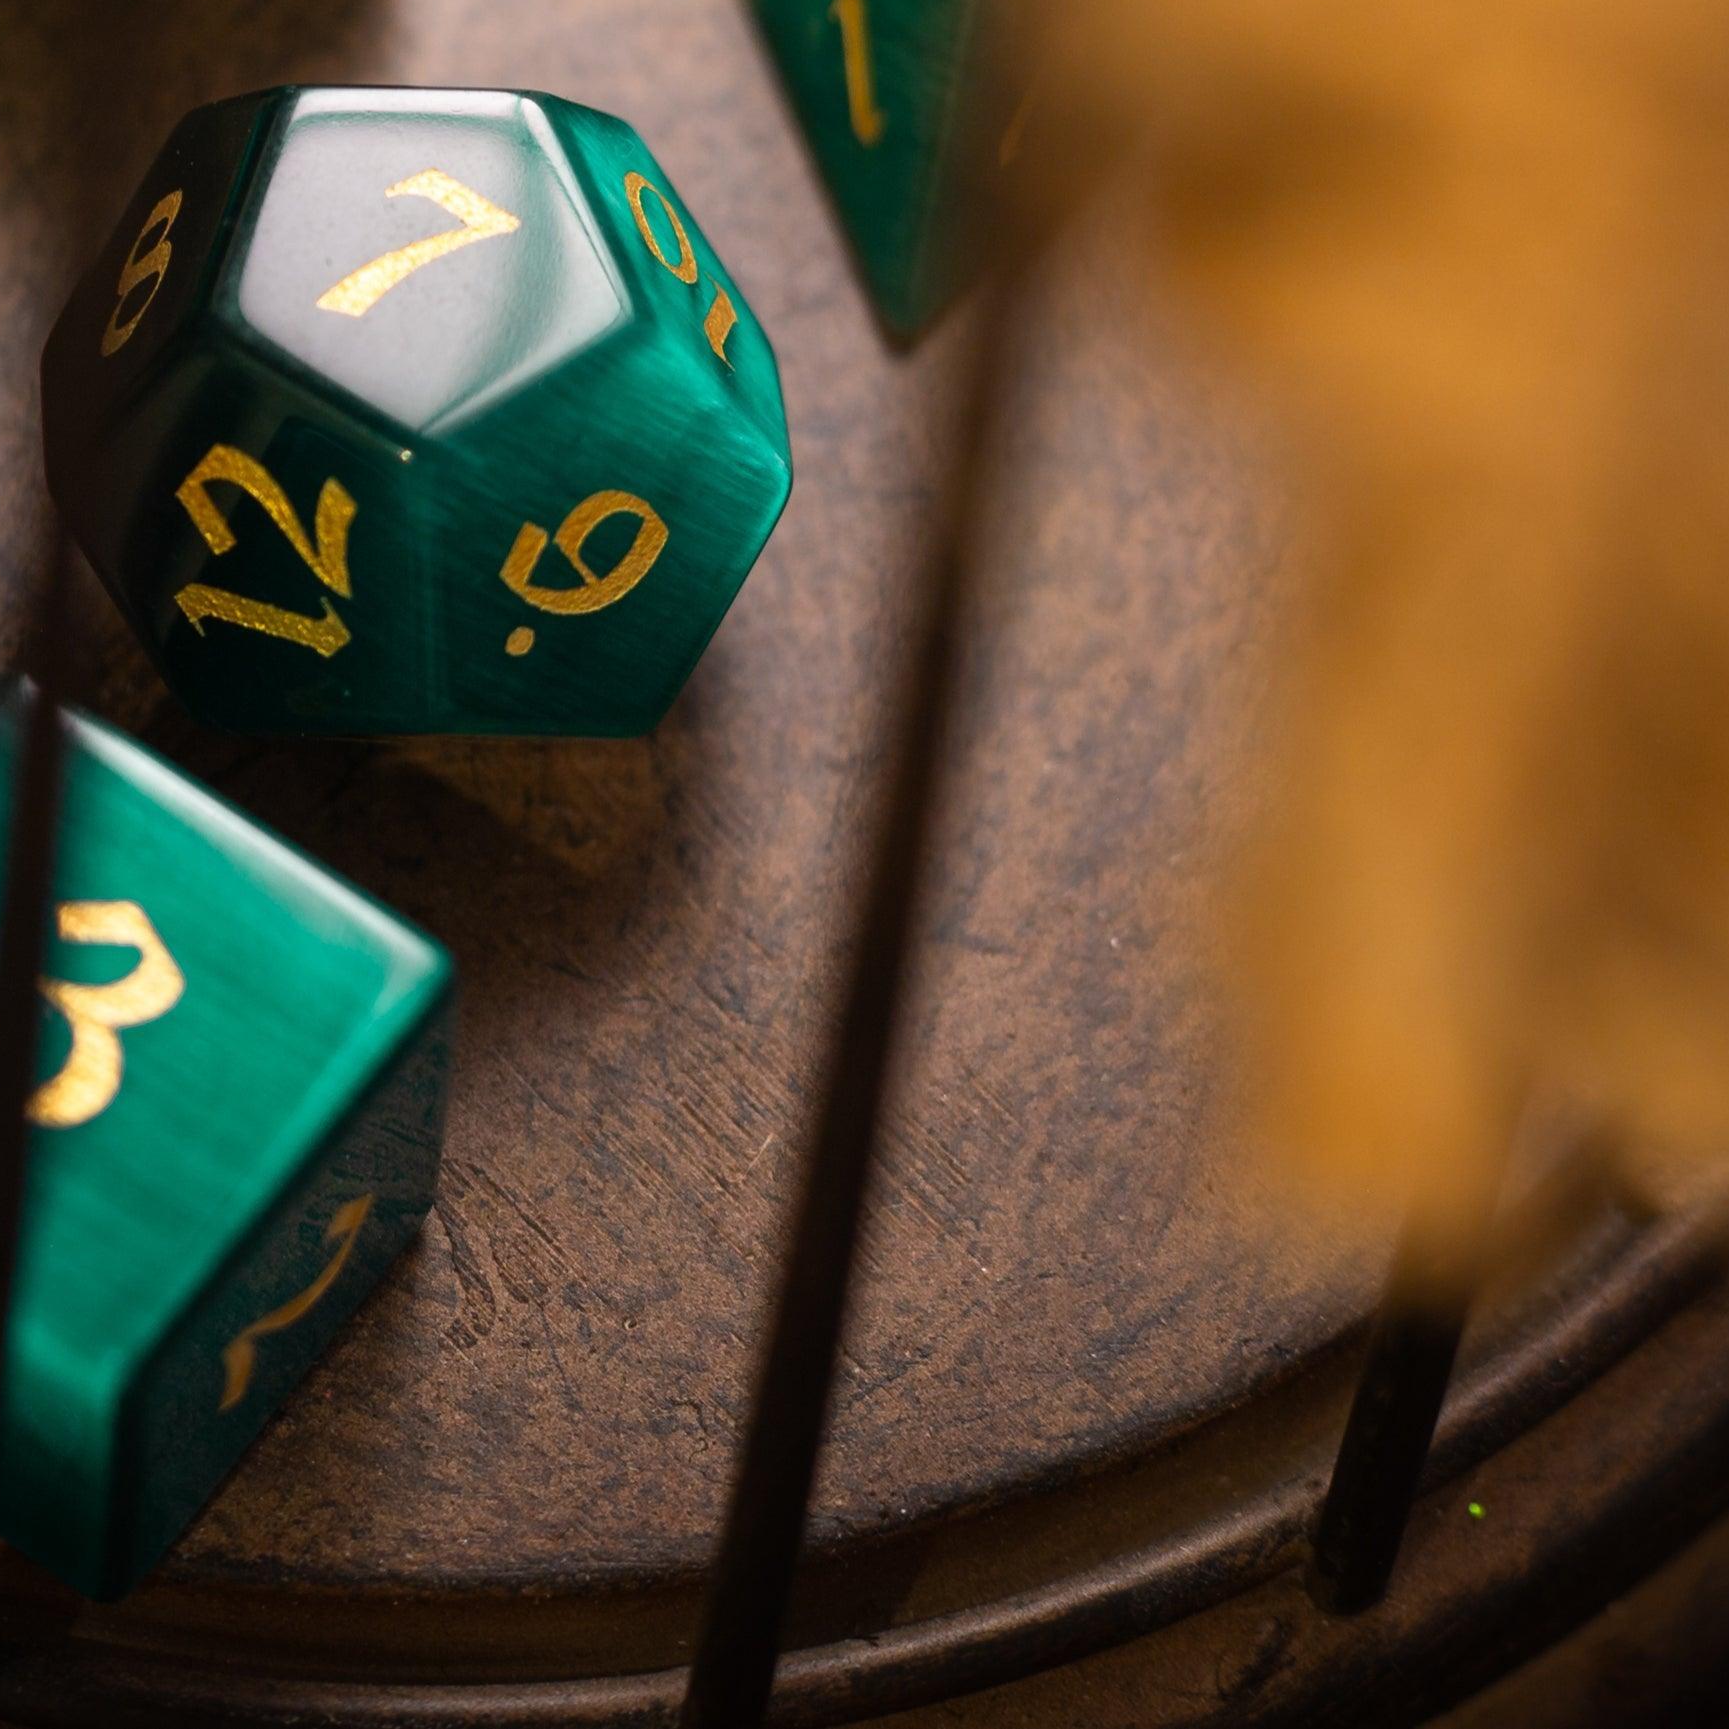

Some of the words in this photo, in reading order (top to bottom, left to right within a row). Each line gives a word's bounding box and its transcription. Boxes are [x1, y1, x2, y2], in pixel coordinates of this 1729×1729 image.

[316, 168, 520, 317] 7
[624, 172, 738, 371] 10
[175, 444, 357, 657] 12
